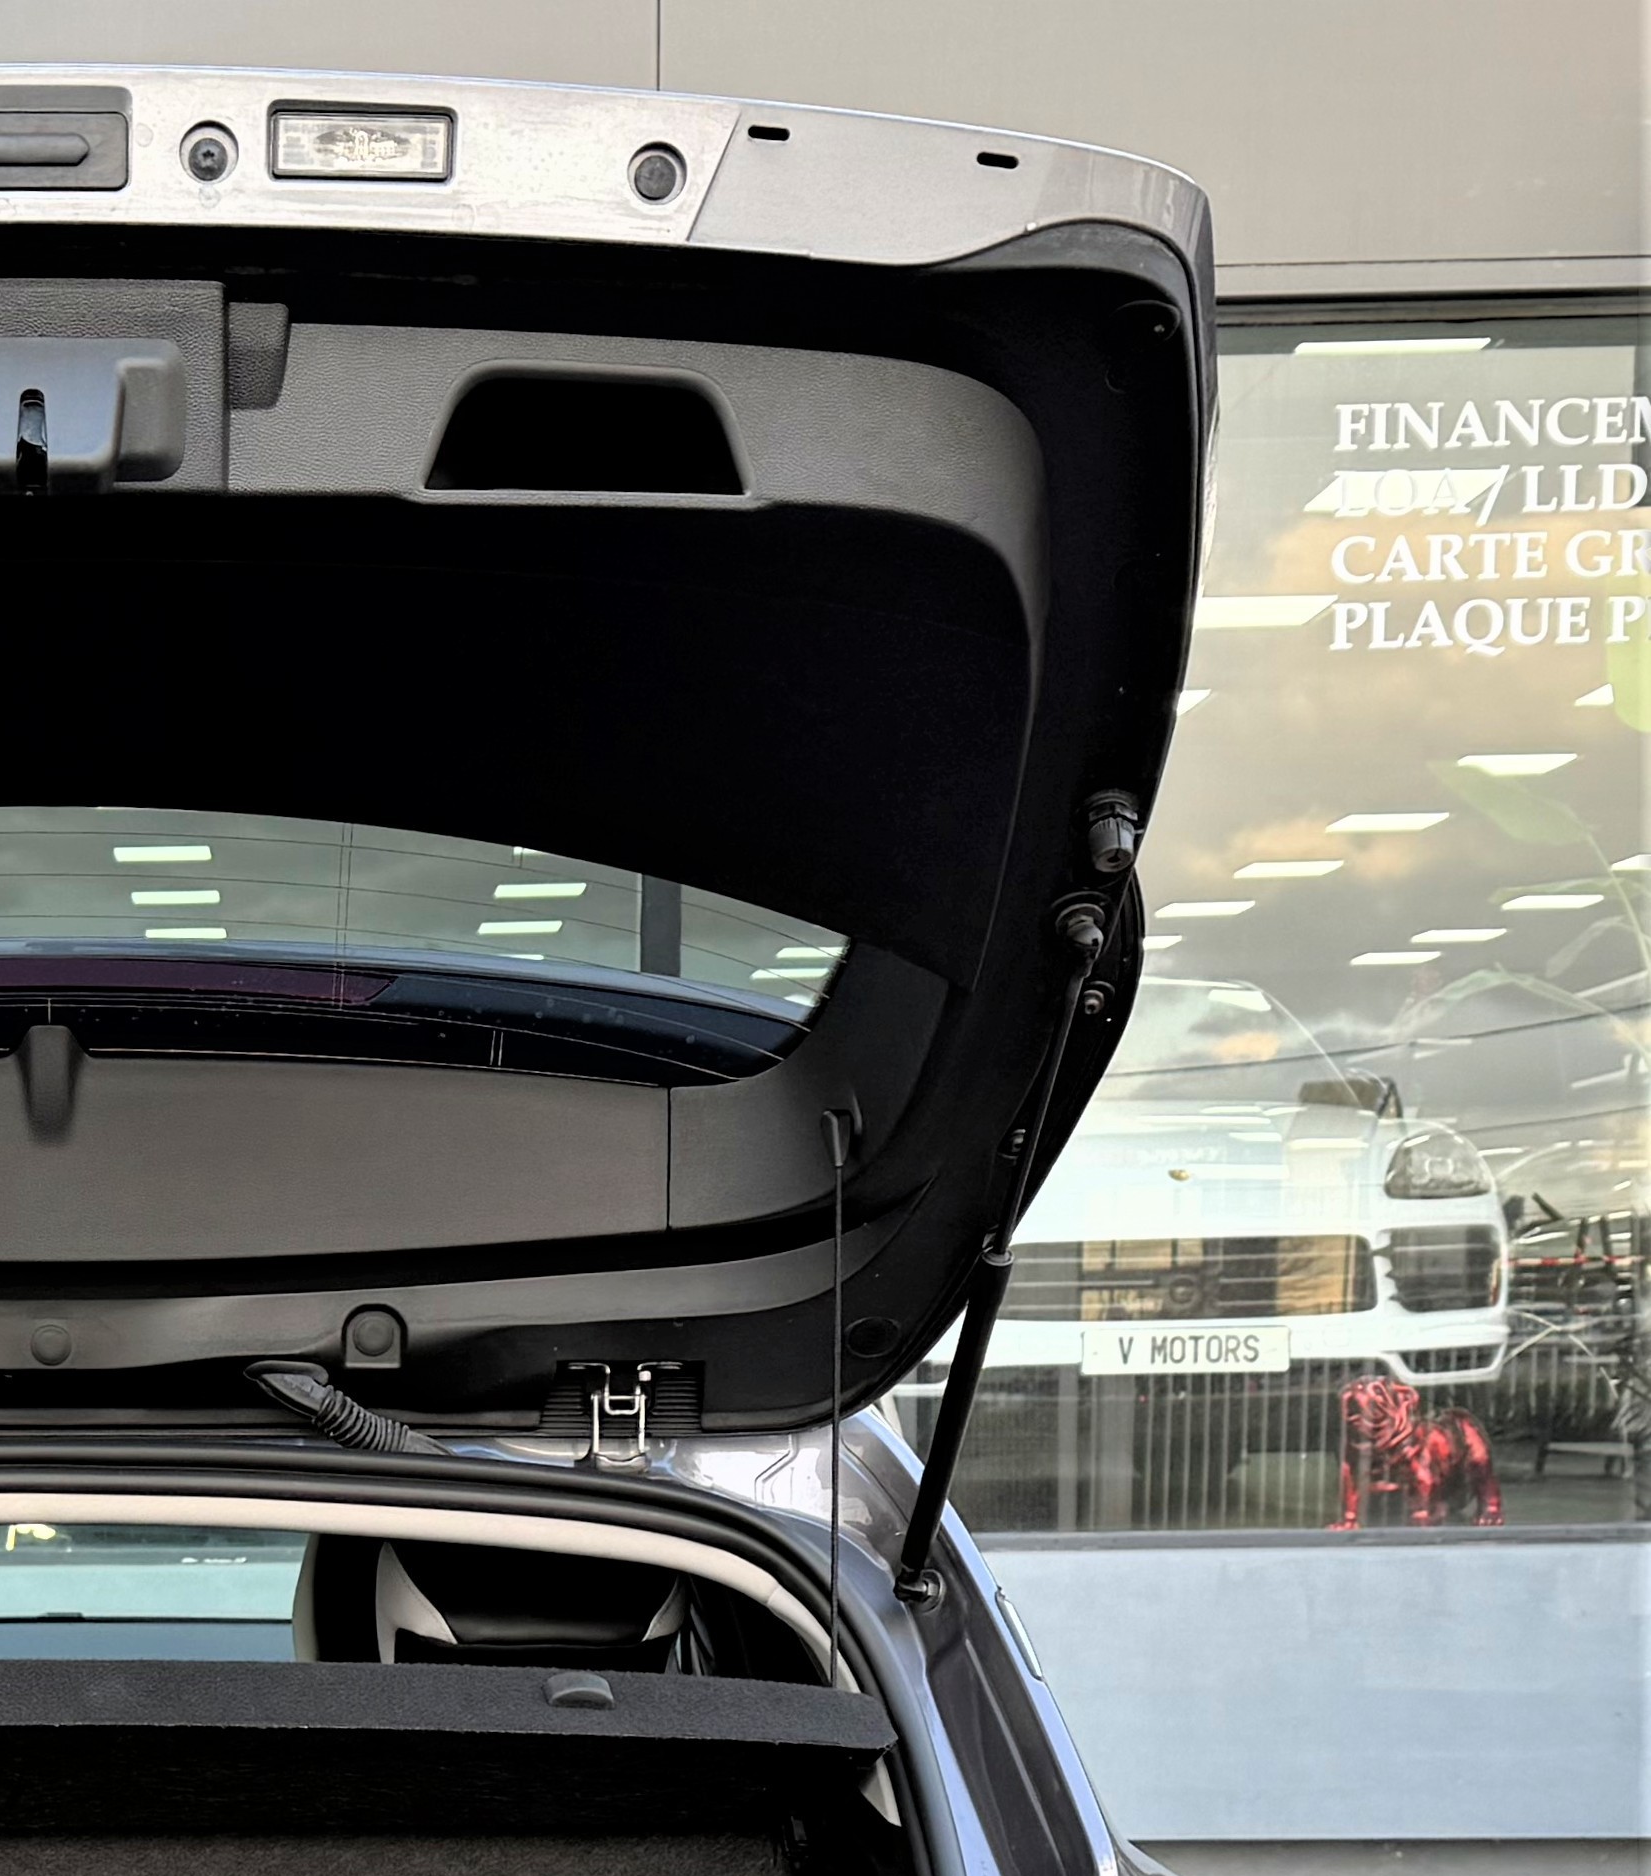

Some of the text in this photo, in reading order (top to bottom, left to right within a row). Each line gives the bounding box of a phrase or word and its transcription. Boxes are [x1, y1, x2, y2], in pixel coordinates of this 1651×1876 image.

[1331, 530, 1549, 584] CARTE
[1329, 595, 1651, 657] PLAQUE P
[1118, 1334, 1260, 1365] V MOTORS
